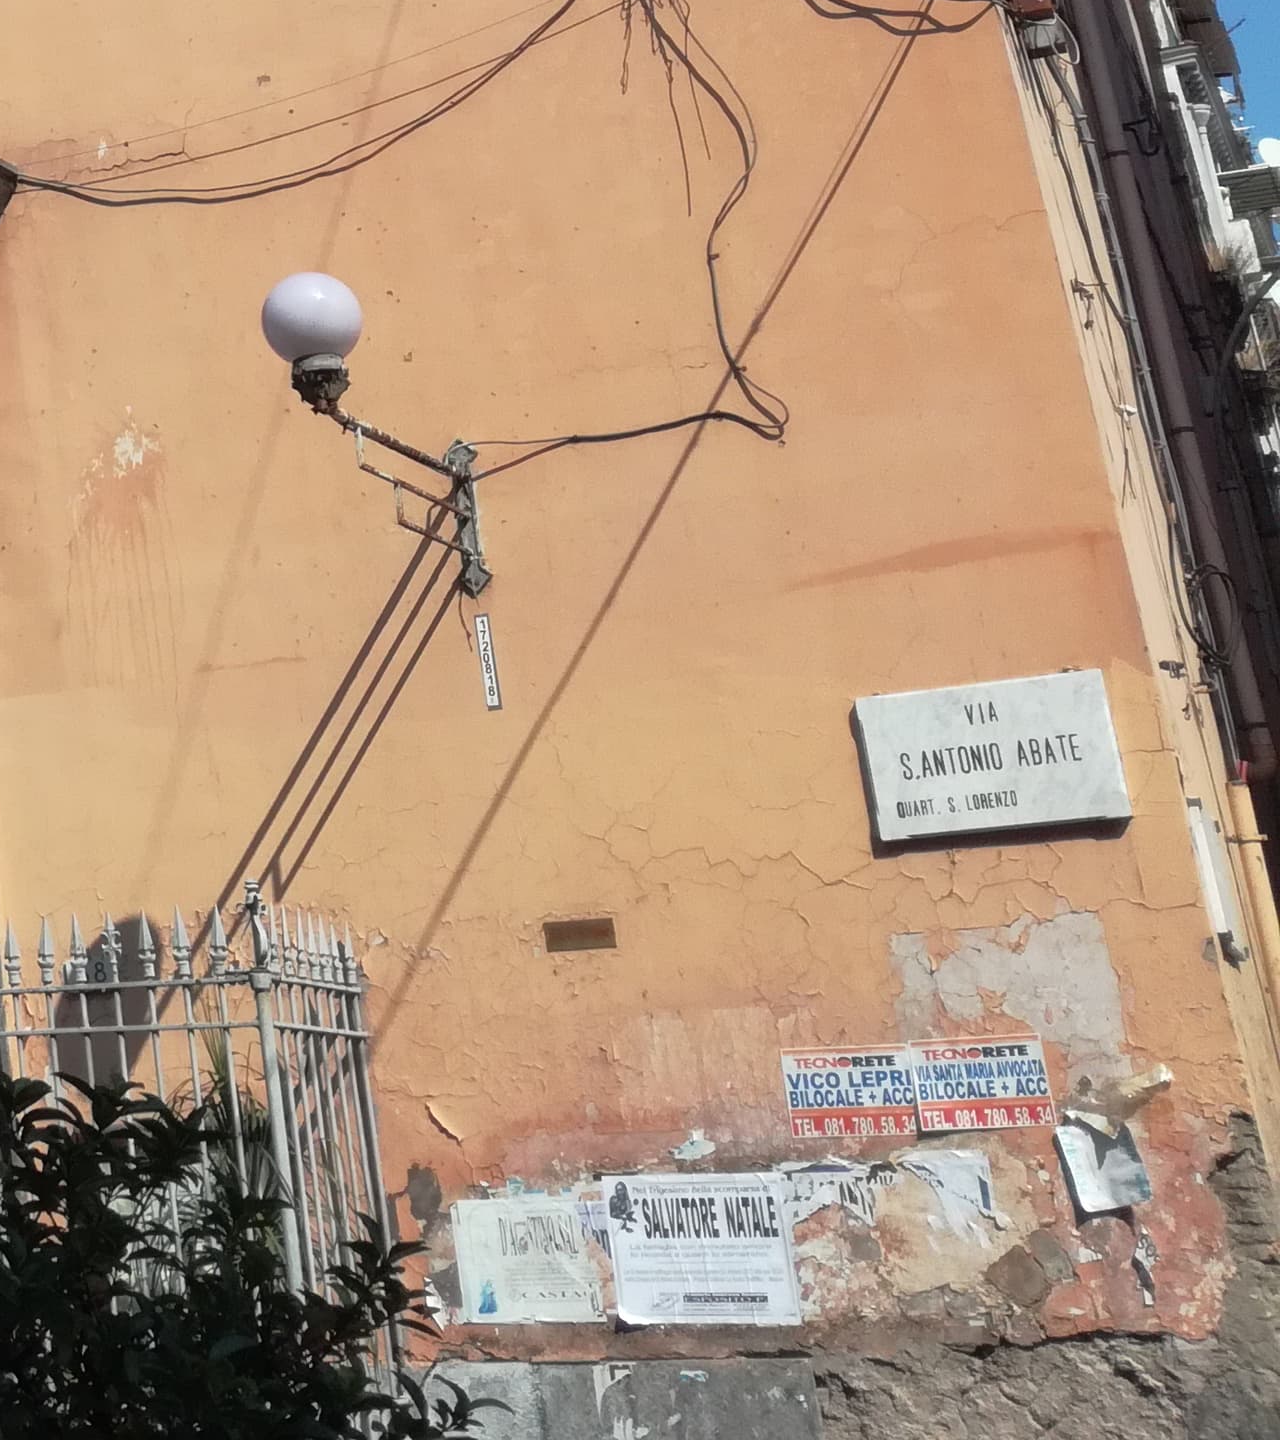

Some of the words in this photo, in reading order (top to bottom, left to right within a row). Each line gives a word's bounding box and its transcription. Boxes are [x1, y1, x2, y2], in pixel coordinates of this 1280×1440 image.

[480, 619, 495, 697] 1720818
[964, 701, 999, 725] VIA
[899, 743, 1003, 781] S.ANTONIO
[1017, 734, 1083, 767] ABATE
[896, 798, 941, 819] QUART.
[947, 796, 961, 814] S.
[965, 790, 1019, 811] LORENZO
[793, 1055, 896, 1069] TECNORETE
[921, 1045, 1029, 1061] TECNORETE
[786, 1071, 840, 1090] VICO
[848, 1070, 912, 1088] LEPRI
[915, 1064, 932, 1082] VIA
[933, 1063, 963, 1081] SANTA
[964, 1061, 995, 1080] MARIA
[997, 1059, 1045, 1078] AVVOCATA
[789, 1089, 865, 1108] BILOCALE
[882, 1087, 914, 1106] ACC
[918, 1080, 997, 1100] BILOCALE
[1016, 1077, 1048, 1096] ACC
[794, 1118, 823, 1136] TEL.
[924, 1110, 953, 1129] TEL.
[641, 1197, 720, 1239] SALVATORE
[724, 1195, 780, 1238] NATALE
